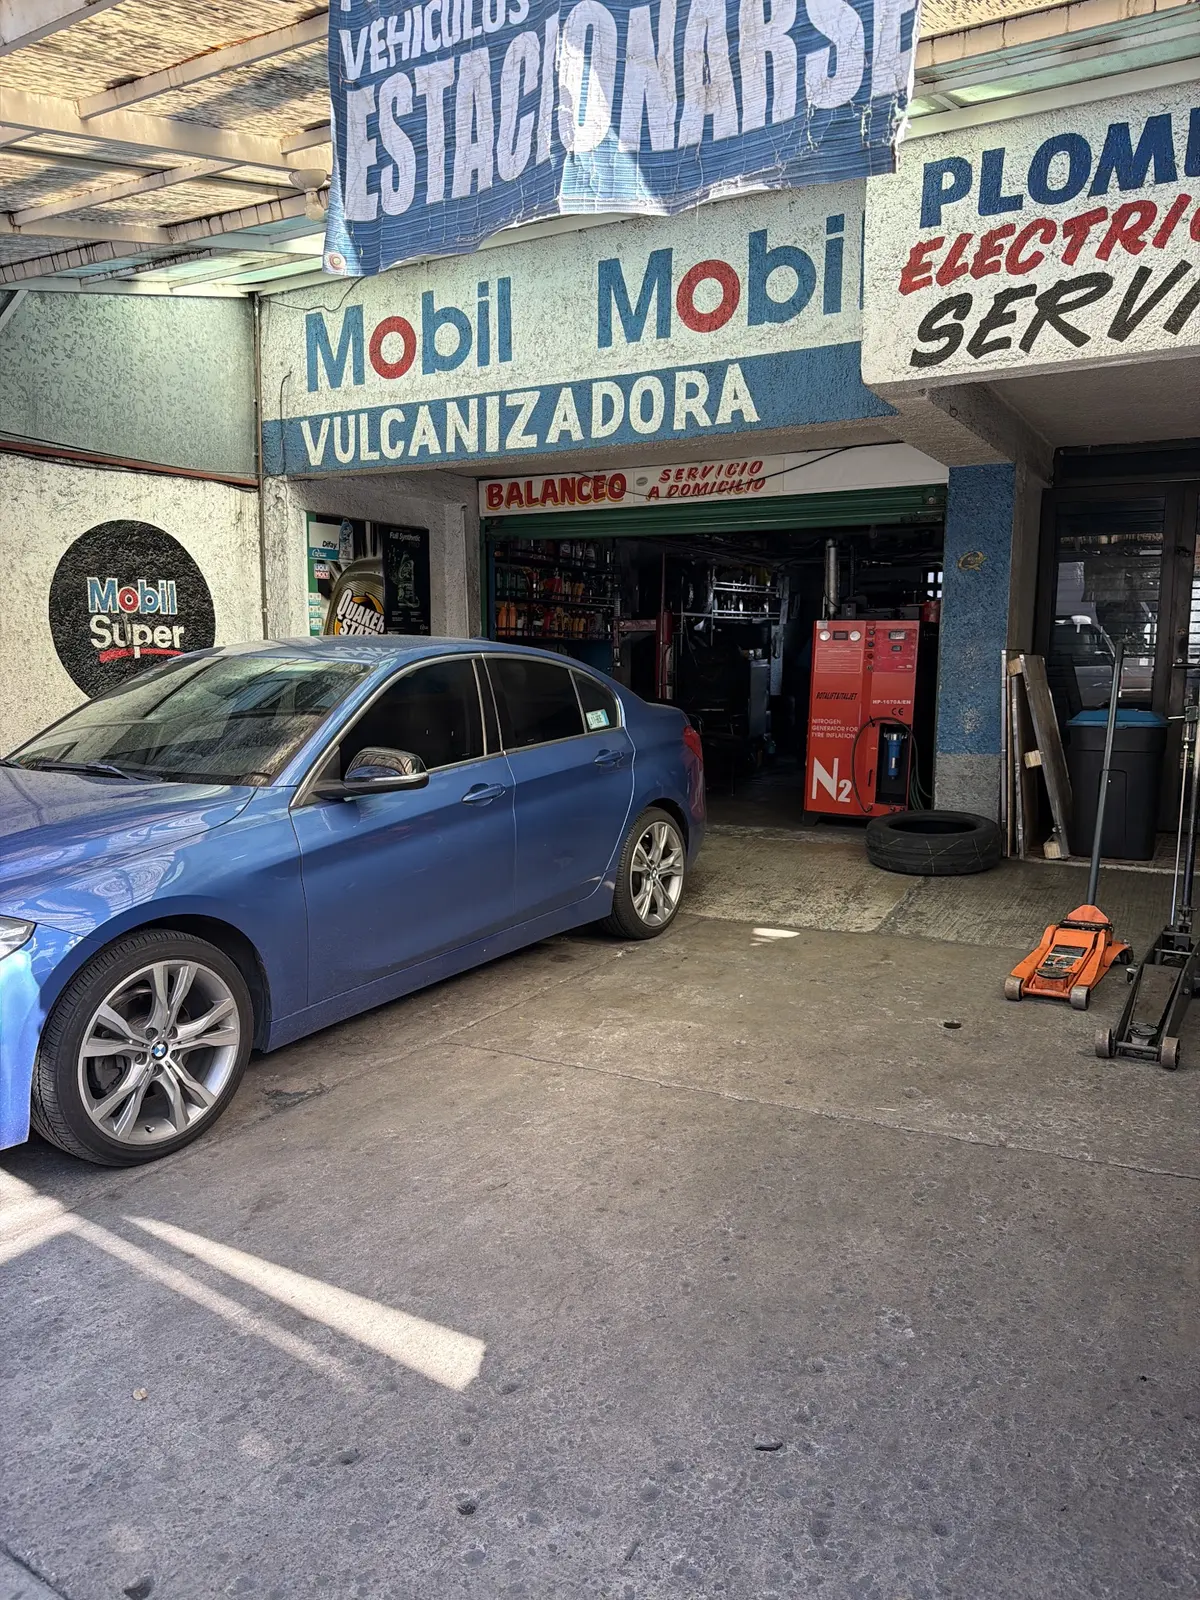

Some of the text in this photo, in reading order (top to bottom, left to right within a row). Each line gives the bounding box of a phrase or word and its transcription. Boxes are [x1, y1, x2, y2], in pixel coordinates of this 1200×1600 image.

[919, 107, 1200, 228] PLOM
[898, 193, 1200, 296] ELECTRI
[597, 213, 864, 349] Mobi
[305, 276, 513, 393] Mobil
[909, 259, 1200, 368] SERVI
[300, 363, 760, 467] VULCANIZADORA
[485, 472, 627, 511] BALANCEO
[645, 477, 766, 502] A DOMICILIO
[659, 460, 764, 484] SERVICIO
[86, 576, 178, 615] Mobil
[89, 614, 185, 659] Super
[340, 618, 379, 635] STA
[811, 756, 853, 803] N2
